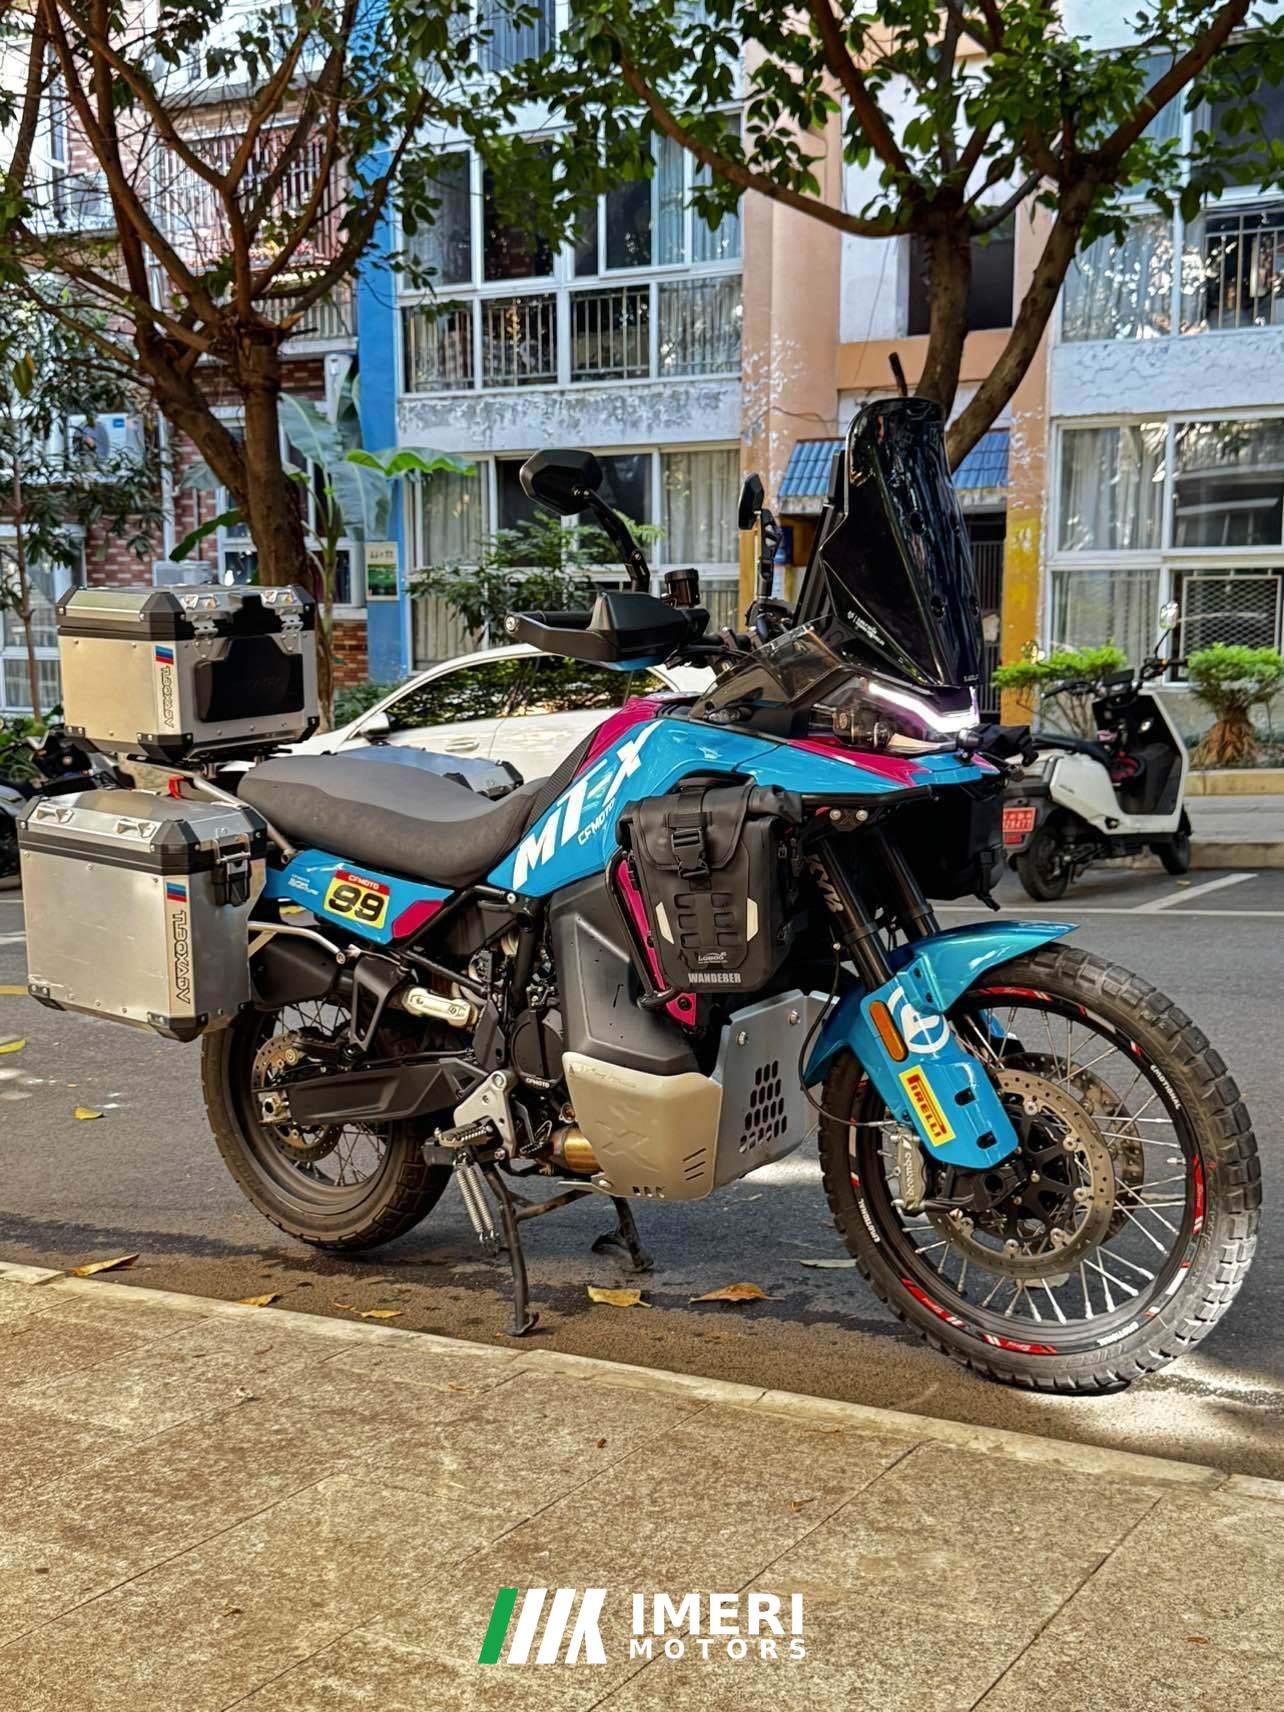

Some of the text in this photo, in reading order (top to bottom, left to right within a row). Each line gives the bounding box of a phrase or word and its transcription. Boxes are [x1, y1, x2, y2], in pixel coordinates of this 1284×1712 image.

[577, 798, 616, 846] CFMOTO
[328, 884, 385, 921] 99
[348, 874, 379, 889] CFMOTO
[907, 1074, 947, 1137] PIRELLI
